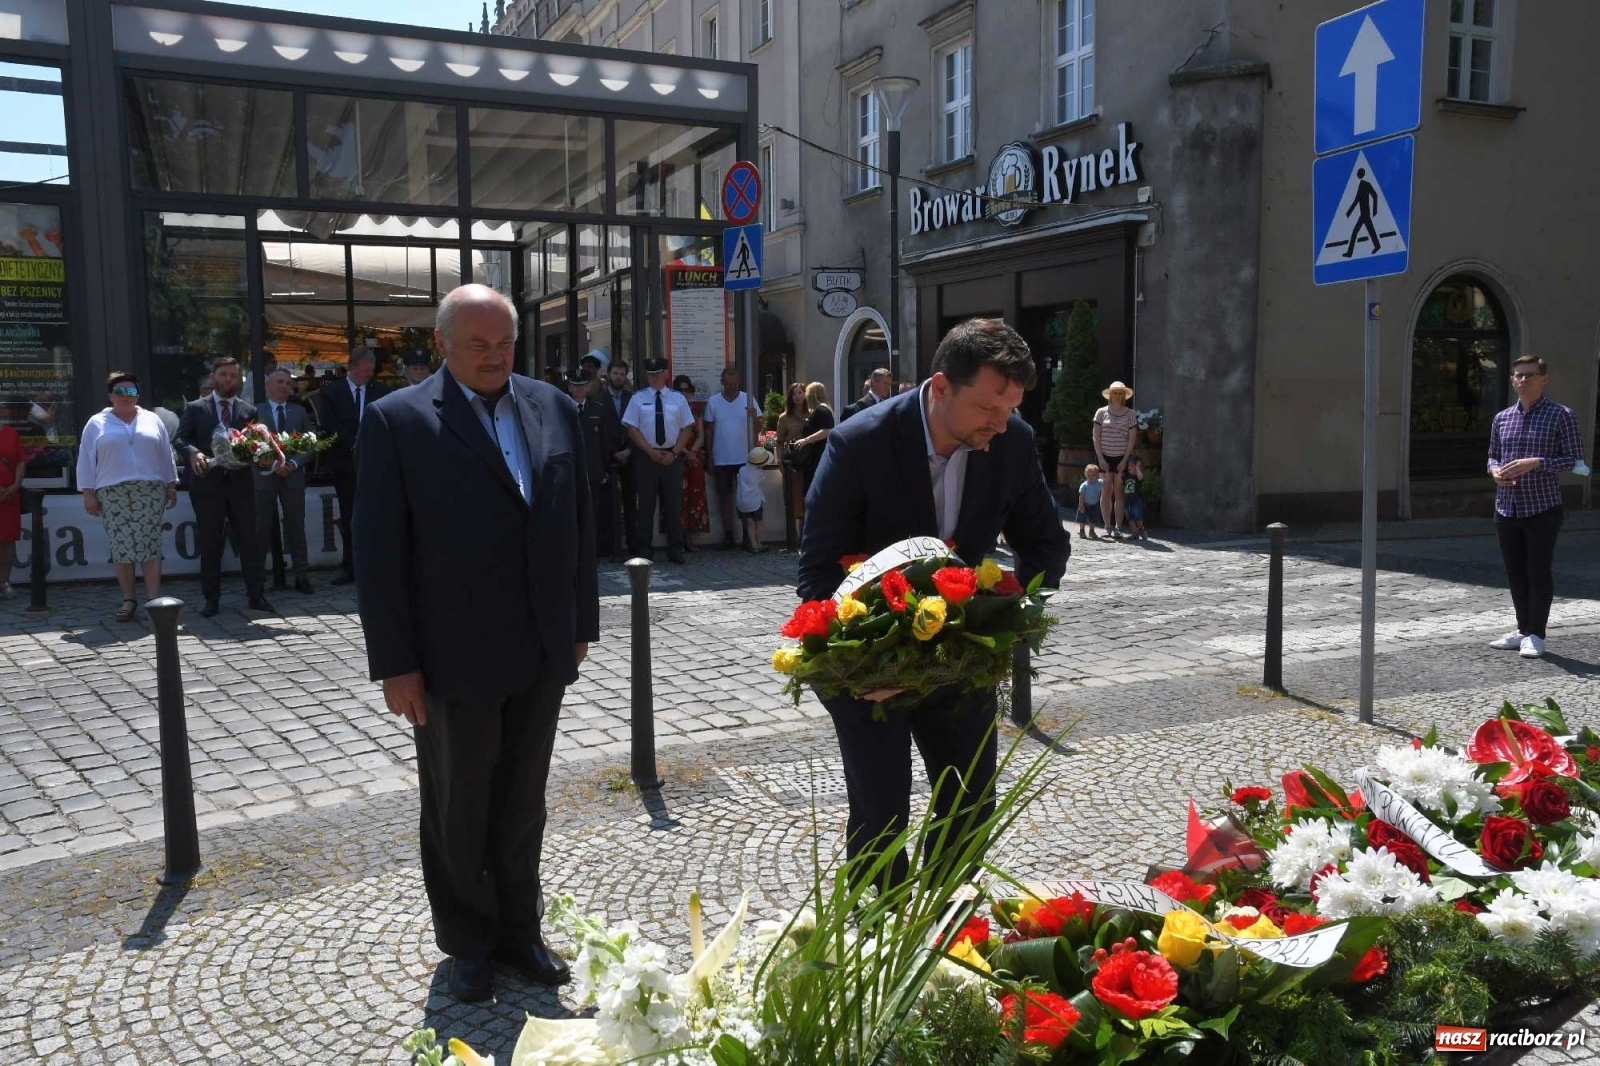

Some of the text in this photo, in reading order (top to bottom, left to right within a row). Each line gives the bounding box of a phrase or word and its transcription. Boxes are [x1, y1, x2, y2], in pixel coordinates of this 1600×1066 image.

[909, 122, 1140, 236] Browar Rynek
[0, 260, 62, 279] DIETETYCZNY
[678, 271, 718, 283] LUNCH
[1, 286, 19, 297] BEZ
